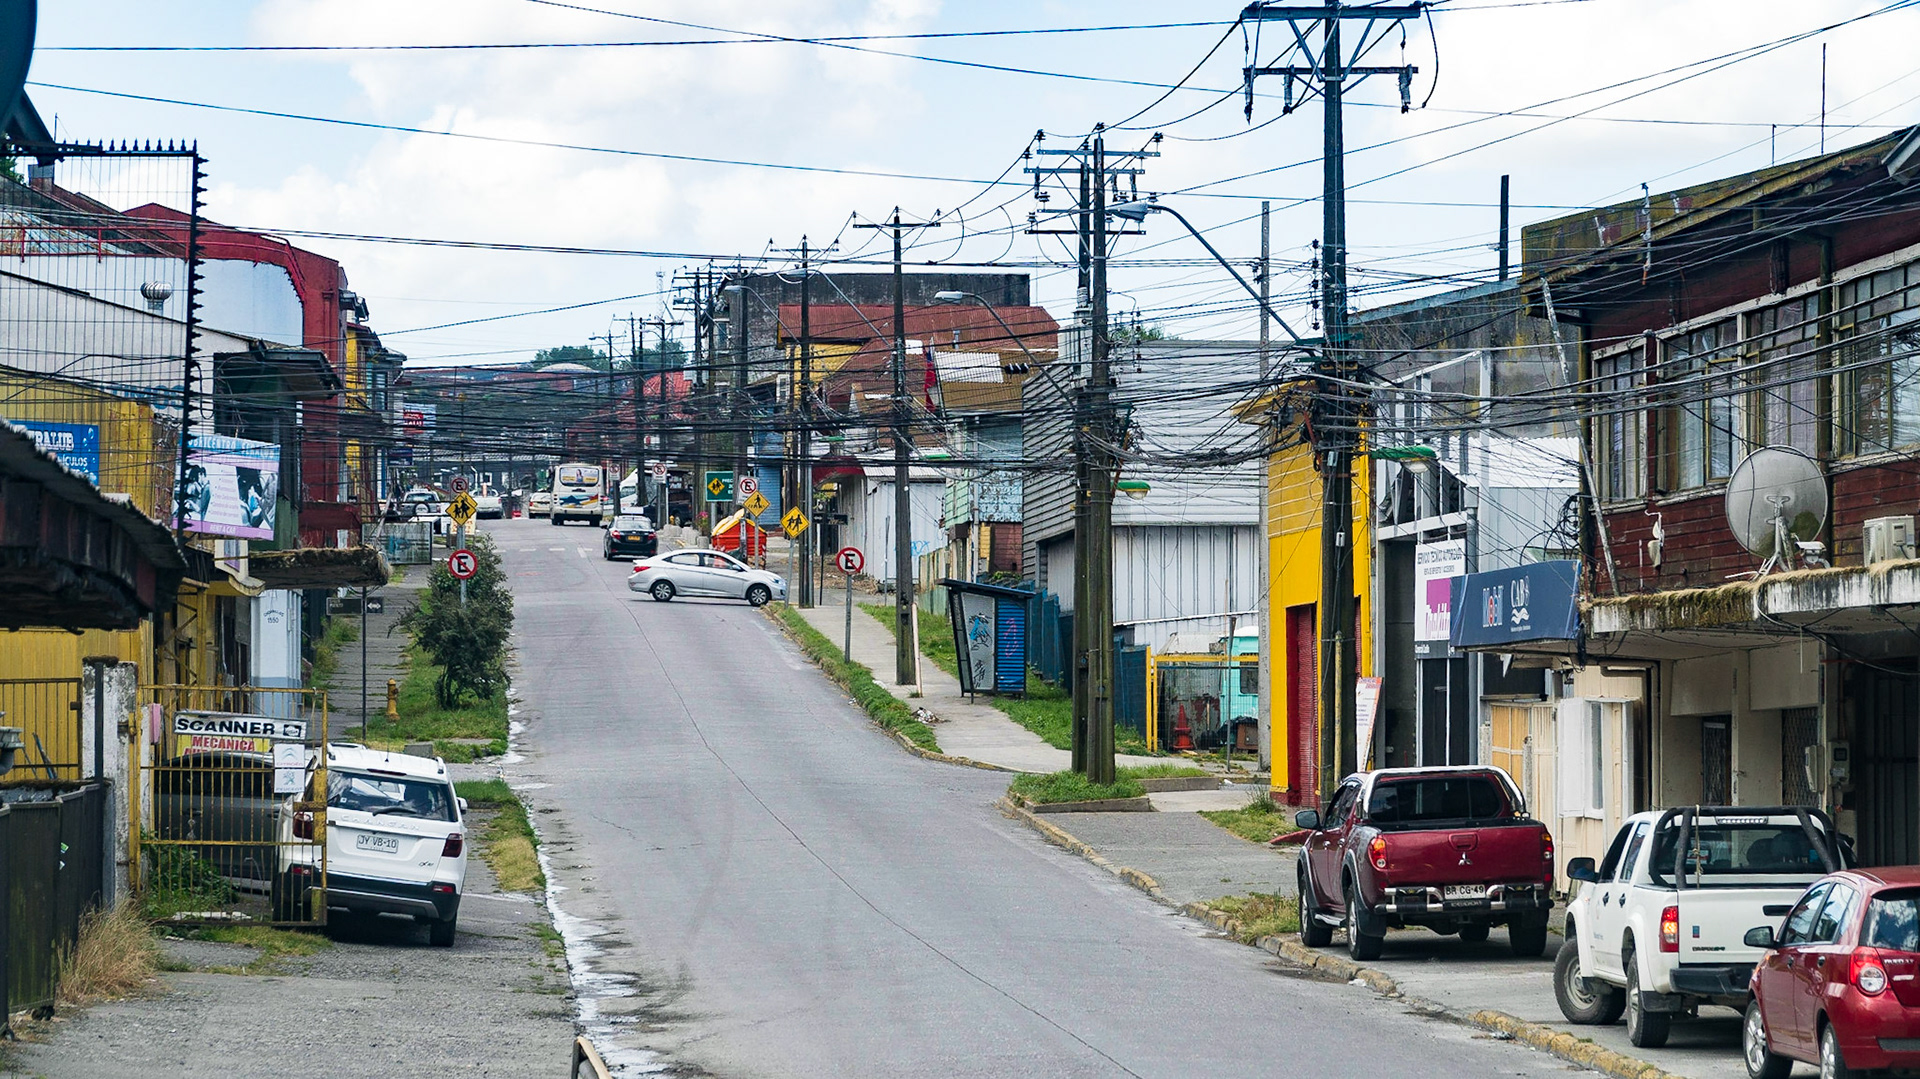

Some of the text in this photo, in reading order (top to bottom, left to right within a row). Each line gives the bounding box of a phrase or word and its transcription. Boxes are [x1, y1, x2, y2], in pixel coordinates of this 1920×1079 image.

[34, 430, 74, 451] RALUB
[457, 556, 469, 573] E
[845, 553, 855, 569] E
[177, 718, 275, 735] SCANNER
[191, 736, 256, 752] MECANICA
[1445, 885, 1484, 895] BR CG-49
